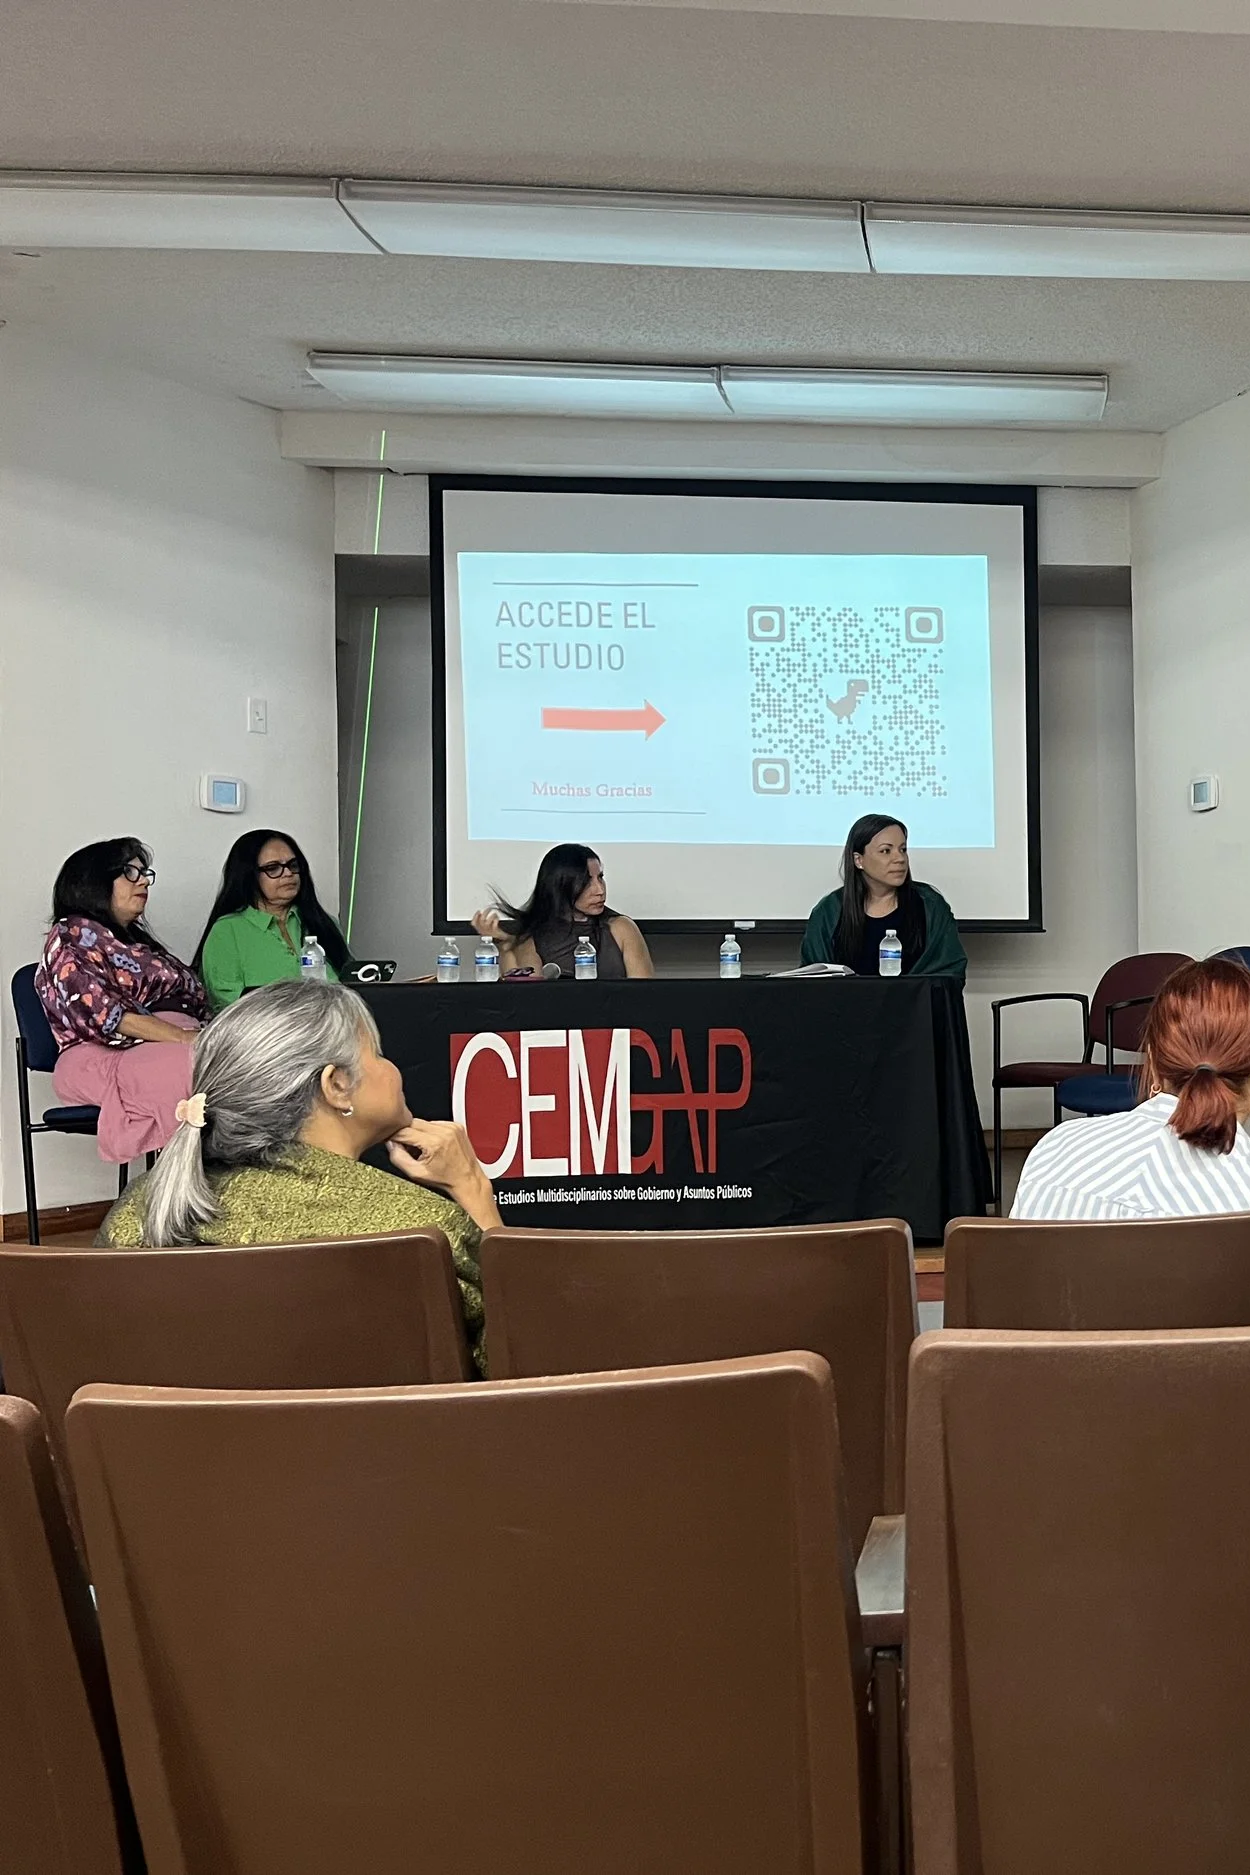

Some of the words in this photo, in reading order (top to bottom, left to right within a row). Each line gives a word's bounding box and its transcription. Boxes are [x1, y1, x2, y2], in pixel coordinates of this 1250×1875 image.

[495, 600, 613, 629] ACCEDE
[623, 602, 656, 629] EL
[498, 642, 625, 671] ESTUDIO
[531, 780, 591, 798] Muchas
[595, 782, 653, 798] Gracias
[498, 1189, 536, 1205] Estudios
[536, 1187, 612, 1204] Multidisciplinarios
[613, 1185, 636, 1200] sobre
[637, 1186, 675, 1201] Gobierno
[676, 1188, 682, 1202] y
[683, 1185, 715, 1199] Asuntos
[716, 1184, 752, 1199] Públicos
